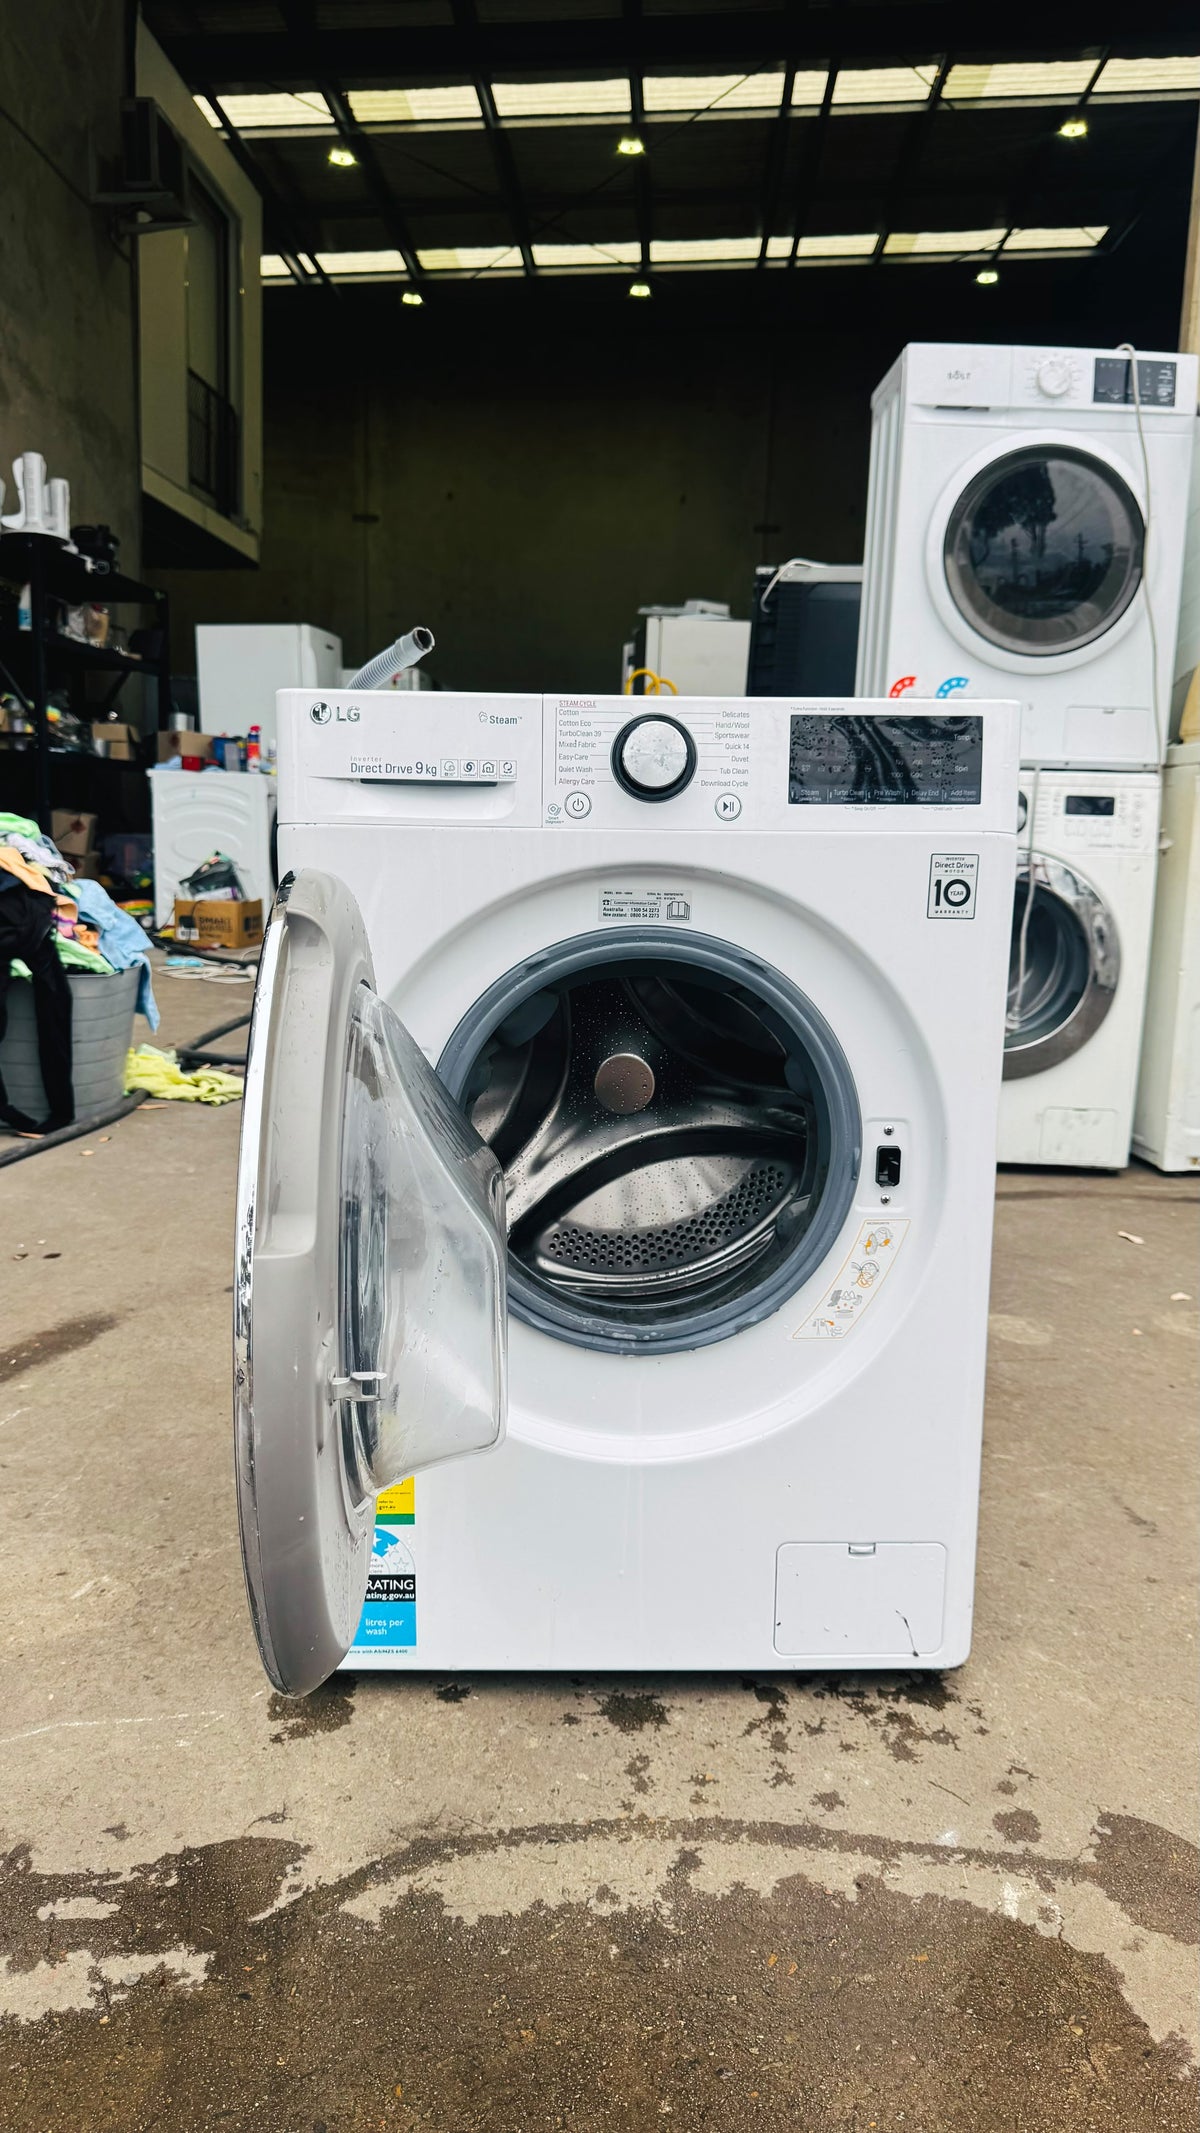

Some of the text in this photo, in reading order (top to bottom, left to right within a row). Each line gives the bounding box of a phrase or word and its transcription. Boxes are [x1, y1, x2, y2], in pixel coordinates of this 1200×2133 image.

[336, 706, 360, 722] LG
[559, 709, 579, 717] Cotton
[714, 732, 750, 741] Sportswear
[559, 753, 573, 761] Easy
[351, 762, 437, 778] Direct Drive 9 kg
[559, 766, 574, 774] Quiet
[955, 765, 969, 774] Spin
[559, 778, 580, 787] Allergy
[732, 781, 748, 789] Cycle
[934, 879, 971, 907] 10
[366, 1580, 414, 1591] RATING
[365, 1618, 405, 1629] litres per
[365, 1627, 387, 1636] wash
